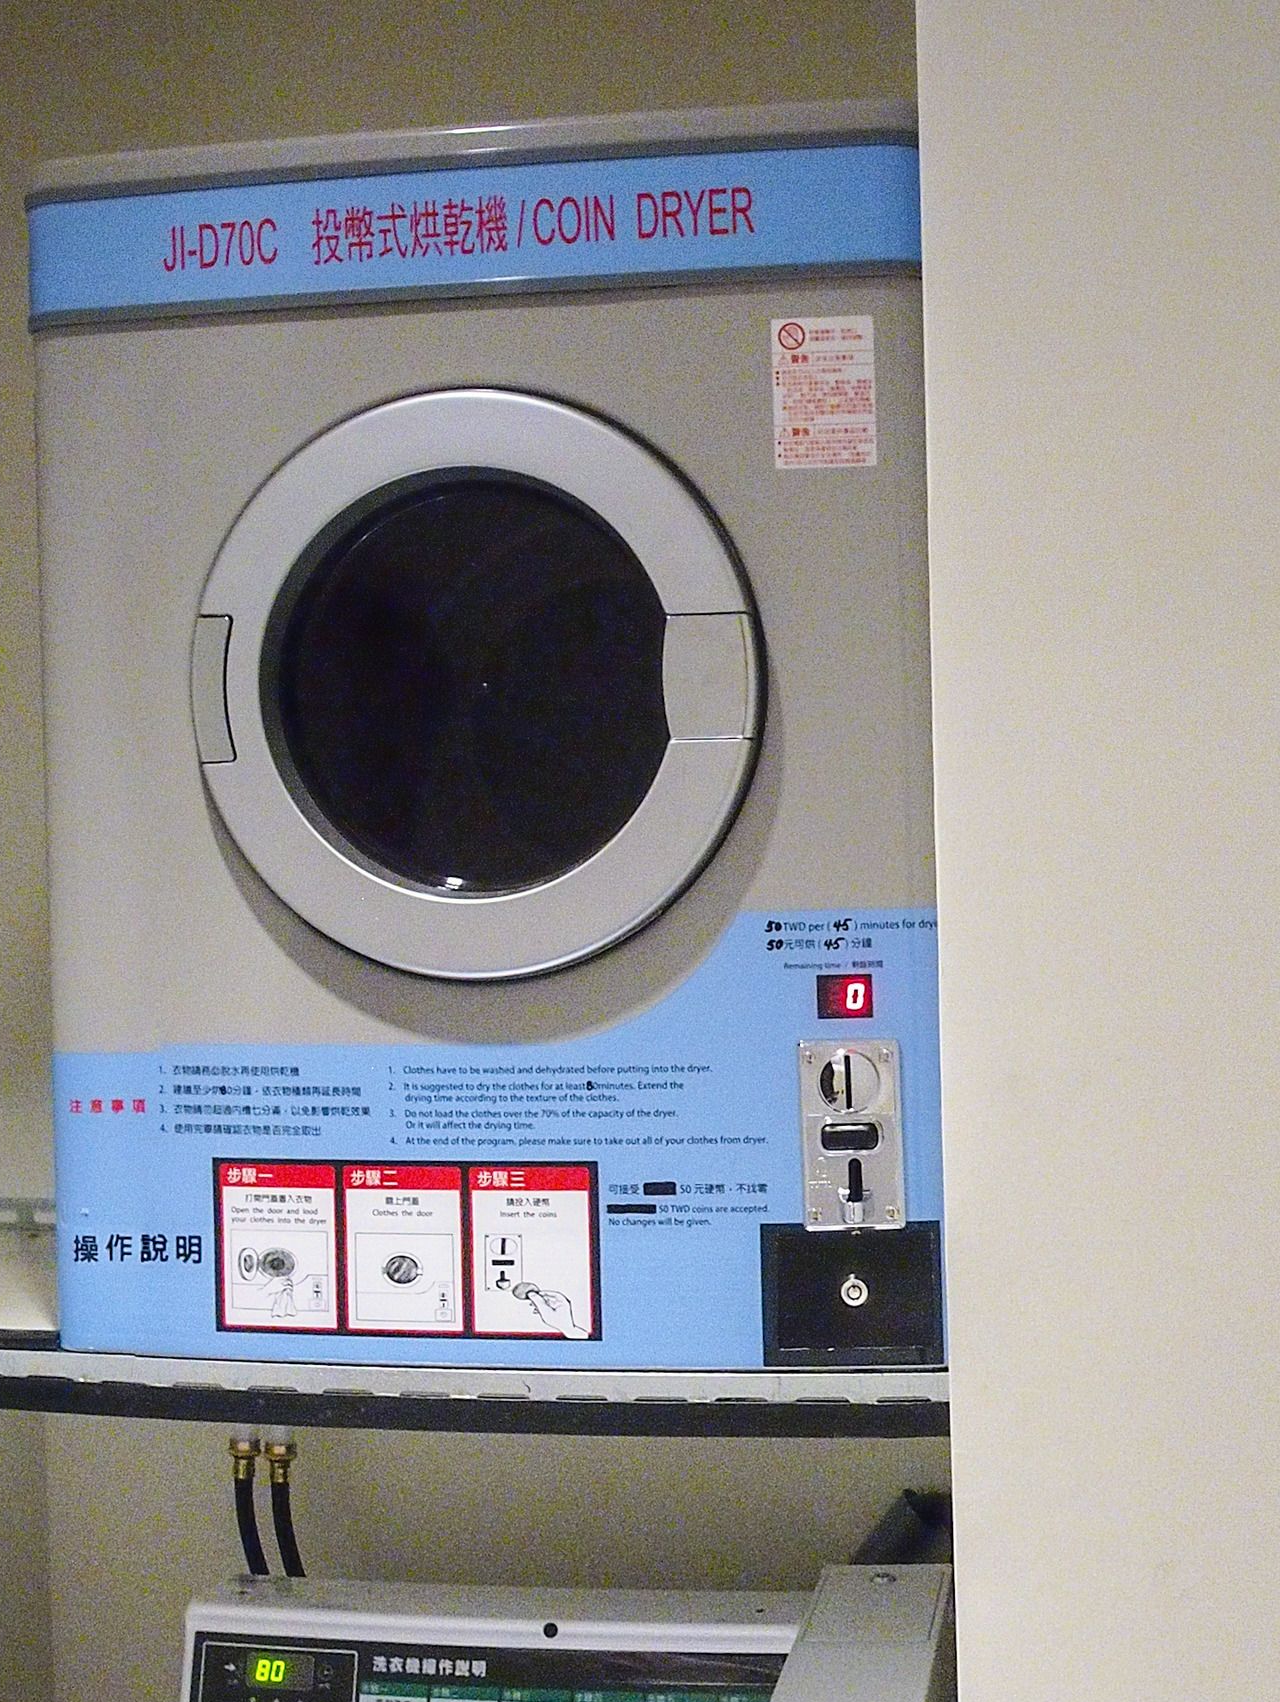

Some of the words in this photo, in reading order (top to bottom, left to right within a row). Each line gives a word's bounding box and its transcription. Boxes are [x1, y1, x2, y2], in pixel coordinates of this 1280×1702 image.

[163, 218, 278, 272] JI-D70C
[312, 195, 508, 265] 投幣式烘乾機
[532, 194, 615, 246] COIN
[636, 186, 755, 240] DRYER
[808, 922, 825, 933] per
[860, 920, 900, 930] minutes
[902, 918, 916, 929] for
[783, 962, 822, 970] Remaining
[846, 982, 865, 1010] 0
[403, 1065, 434, 1074] Clothes
[436, 1065, 456, 1074] have
[459, 1065, 468, 1074] to
[470, 1065, 480, 1074] be
[482, 1065, 515, 1074] washed
[517, 1065, 533, 1074] and
[535, 1065, 585, 1076] dehydrated
[587, 1065, 615, 1073] before
[617, 1065, 649, 1075] putting
[651, 1064, 668, 1073] into
[671, 1064, 685, 1073] the
[687, 1064, 713, 1074] dryer.
[403, 1082, 409, 1090] It
[412, 1082, 418, 1090] is
[420, 1082, 463, 1093] suggested
[465, 1083, 475, 1091] to
[476, 1082, 490, 1092] dry
[492, 1082, 506, 1091] the
[508, 1082, 539, 1091] clothes
[541, 1081, 553, 1090] for
[555, 1082, 564, 1090] at
[638, 1081, 668, 1090] Extend
[669, 1081, 683, 1090] the
[405, 1094, 432, 1104] drying
[434, 1094, 453, 1102] time
[455, 1094, 496, 1104] according
[499, 1094, 508, 1102] to
[510, 1094, 524, 1102] the
[526, 1094, 557, 1102] texture
[559, 1093, 568, 1102] of
[569, 1093, 584, 1102] the
[585, 1093, 619, 1102] clothes.
[68, 1098, 148, 1114] 注意事項
[405, 1109, 417, 1118] Do
[418, 1109, 433, 1118] not
[435, 1109, 453, 1118] load
[455, 1109, 469, 1118] the
[471, 1109, 502, 1118] clothes
[503, 1110, 522, 1118] over
[524, 1109, 538, 1118] the
[561, 1109, 570, 1118] of
[572, 1109, 586, 1118] the
[588, 1109, 623, 1119] capacity
[625, 1108, 635, 1117] of
[637, 1108, 651, 1117] the
[653, 1108, 678, 1118] dryer.
[406, 1120, 416, 1129] Or
[418, 1120, 424, 1129] it
[426, 1120, 440, 1129] will
[442, 1120, 466, 1129] affect
[468, 1121, 481, 1129] the
[483, 1121, 512, 1131] drying
[513, 1121, 534, 1129] time.
[405, 1136, 415, 1145] At
[417, 1136, 431, 1145] the
[433, 1136, 449, 1145] end
[451, 1136, 460, 1145] of
[461, 1136, 475, 1145] the
[518, 1137, 546, 1147] please
[548, 1136, 571, 1145] make
[593, 1137, 603, 1145] to
[605, 1136, 624, 1145] take
[625, 1137, 640, 1145] out
[642, 1136, 652, 1145] all
[654, 1136, 664, 1145] of
[665, 1138, 684, 1147] your
[686, 1136, 718, 1145] clothes
[720, 1135, 741, 1144] from
[742, 1135, 769, 1146] dryer.
[227, 1166, 273, 1184] 步驟一
[350, 1169, 398, 1186] 步驟二
[477, 1170, 525, 1187] 步驟三
[608, 1183, 640, 1195] 可接受
[231, 1206, 249, 1215] Open
[658, 1204, 668, 1213] 50
[670, 1204, 690, 1213] TWD
[692, 1204, 713, 1213] coins
[715, 1205, 729, 1213] are
[309, 1217, 327, 1225] dryer
[608, 1218, 620, 1226] No
[622, 1217, 656, 1228] changes
[658, 1217, 672, 1226] will
[674, 1218, 685, 1226] be
[686, 1218, 711, 1228] given.
[74, 1233, 202, 1264] 操作說明
[255, 1659, 285, 1682] 80
